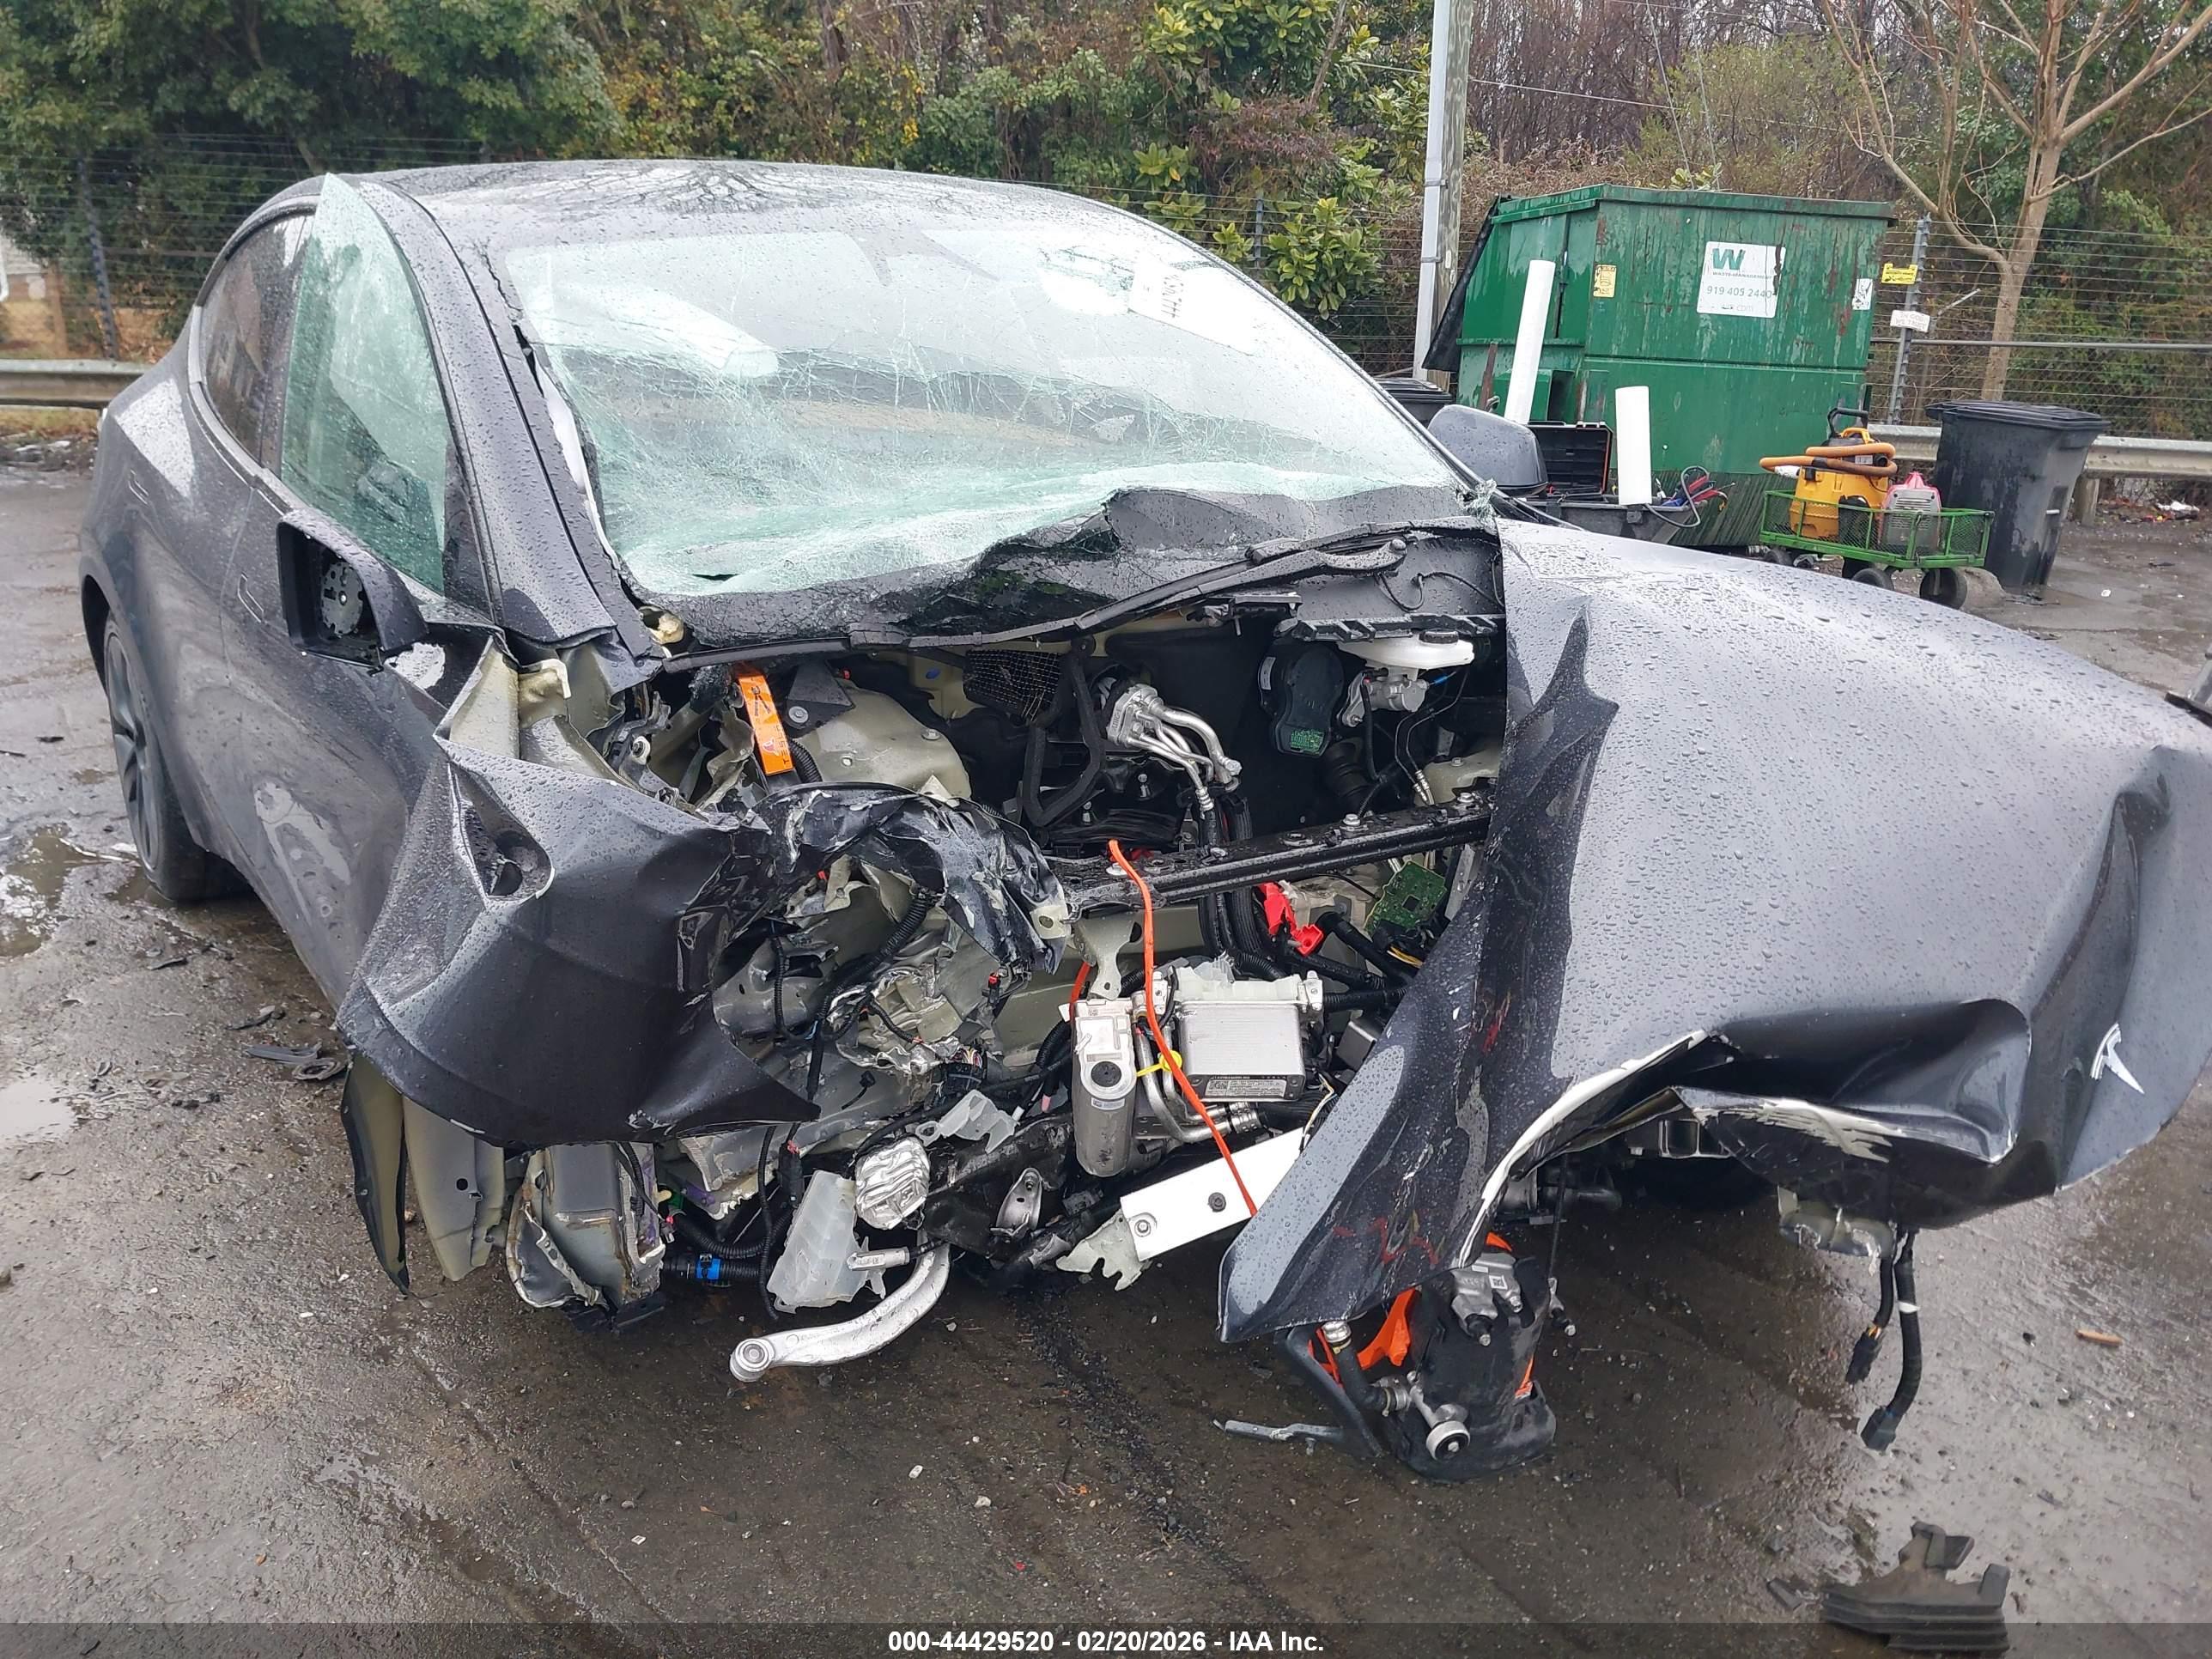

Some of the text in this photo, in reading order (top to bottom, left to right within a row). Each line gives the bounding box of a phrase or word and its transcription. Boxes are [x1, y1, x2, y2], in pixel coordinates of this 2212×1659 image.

[1707, 285, 1772, 299] 919 405 2440
